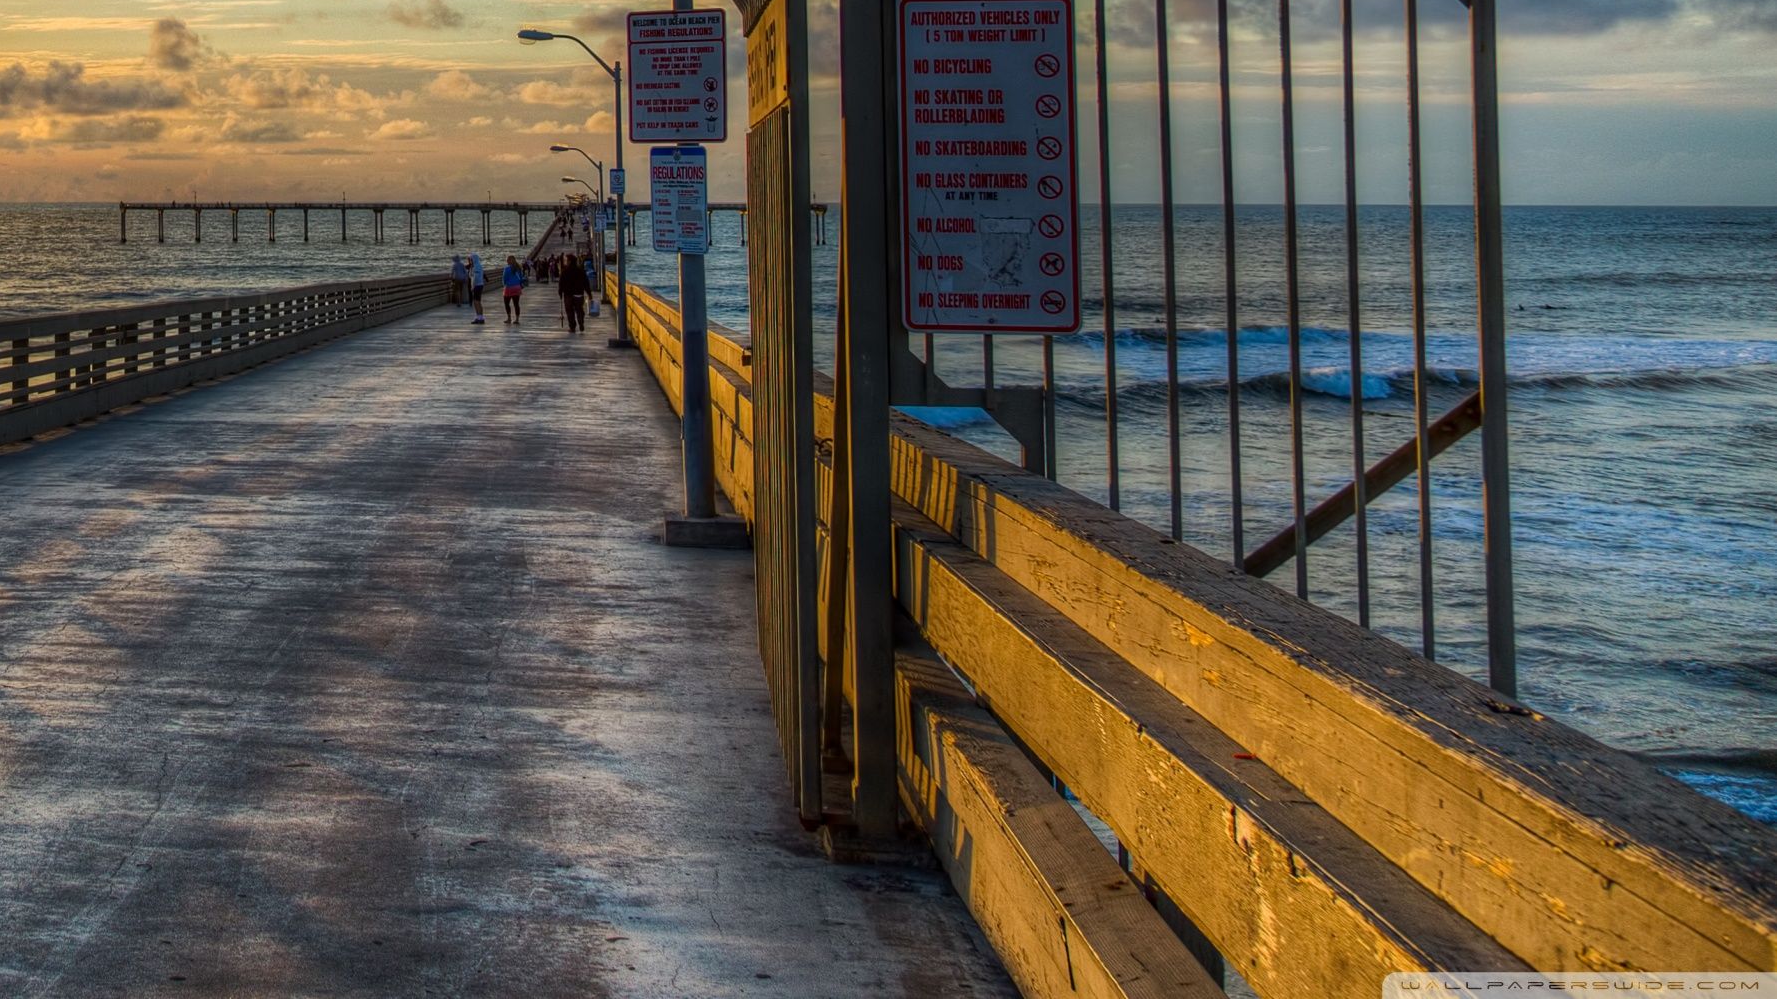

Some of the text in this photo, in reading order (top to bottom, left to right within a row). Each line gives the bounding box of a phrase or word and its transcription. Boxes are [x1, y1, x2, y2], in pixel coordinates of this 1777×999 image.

[660, 18, 667, 26] TO
[707, 16, 720, 24] PIER
[911, 10, 1060, 26] AUTHORIZED VEHICLES ONLY
[640, 27, 713, 38] FISHING REGULATIONS
[944, 30, 964, 42] TON
[968, 30, 1006, 42] WEIGHT
[1010, 30, 1037, 41] LIMIT
[913, 59, 992, 74] NO BICYCLING
[914, 90, 1003, 104] NO SKATING OR
[915, 109, 1005, 124] ROLLERBLADING
[915, 141, 1027, 156] NO SKATEBOARDING
[653, 166, 704, 180] REGULATIONS
[916, 173, 1027, 188] NO GLASS CONTAINERS
[945, 192, 998, 200] AT ANY TIME
[917, 218, 977, 233] NO ALCOHOL
[918, 256, 963, 270] NO DOGS
[919, 293, 1031, 309] NO SLEEPING OVERNIGHT
